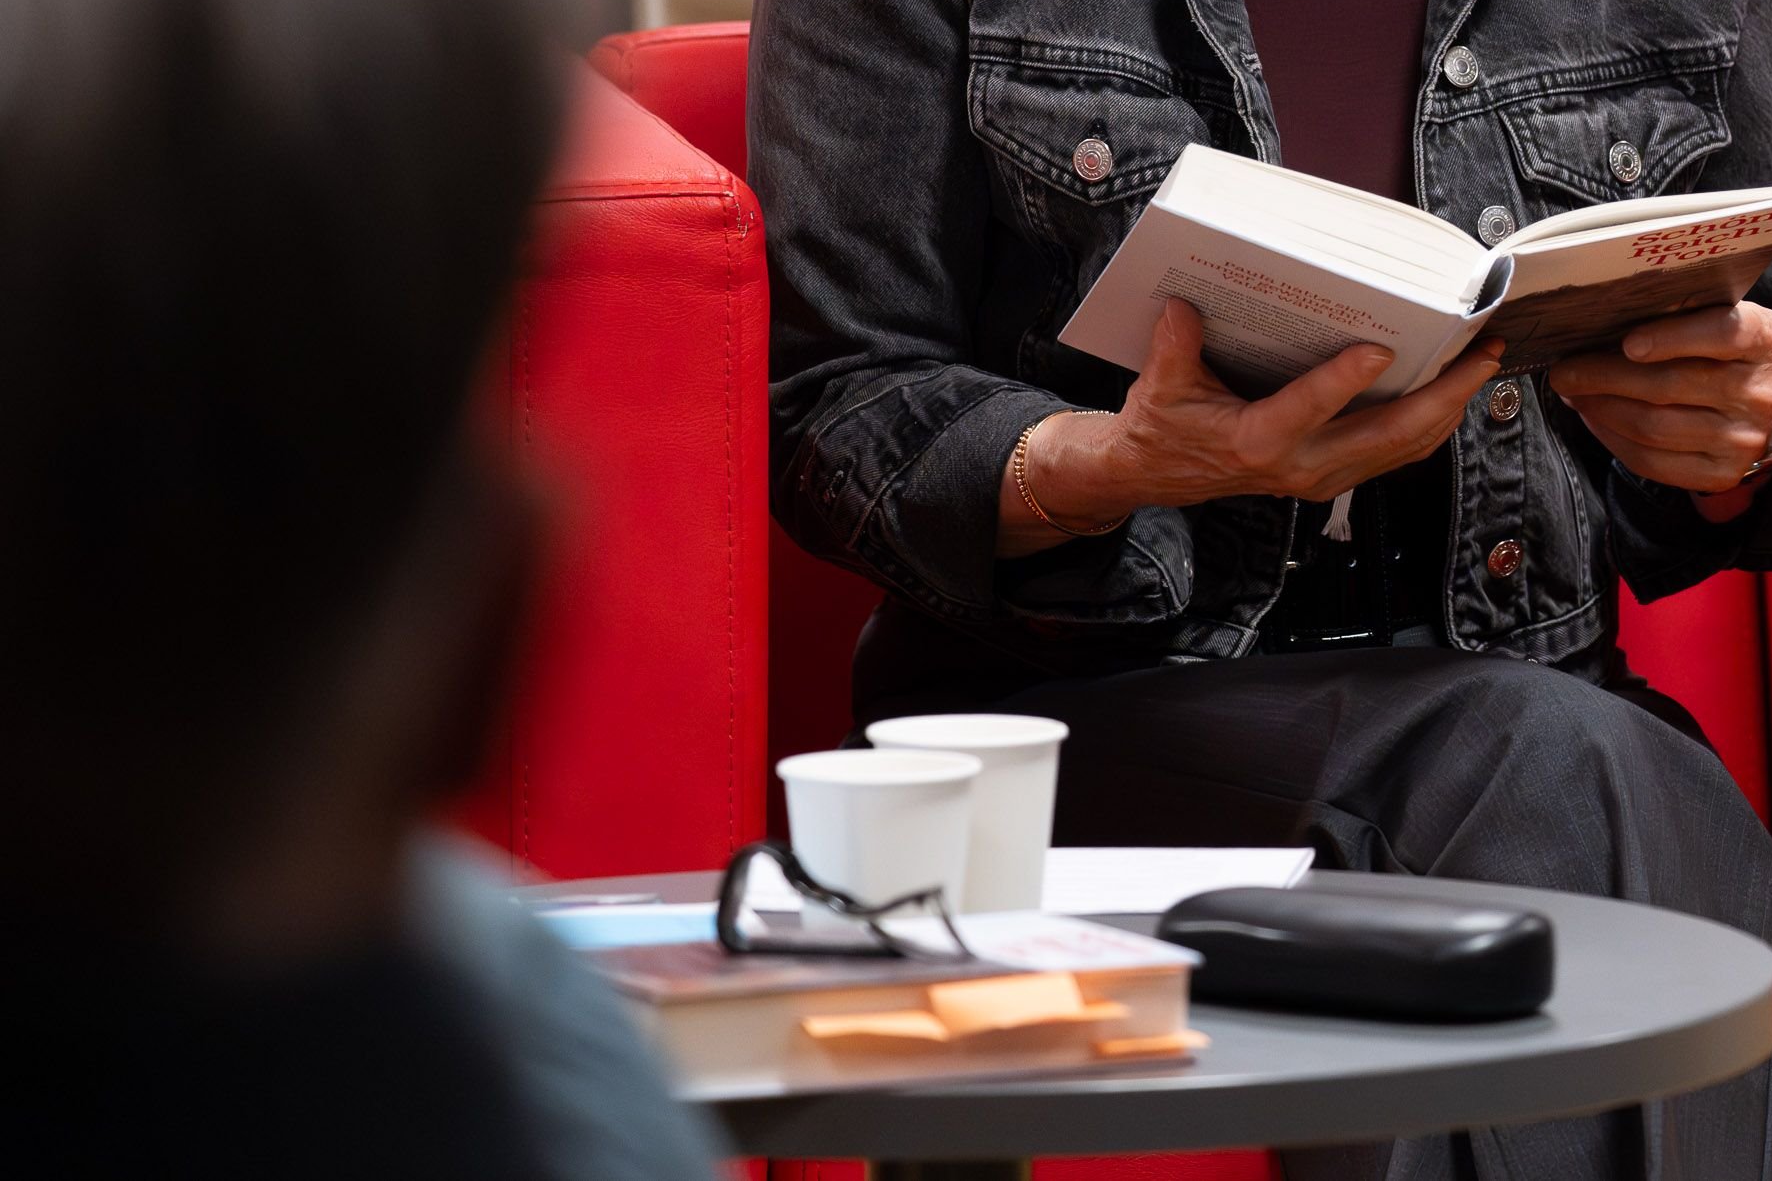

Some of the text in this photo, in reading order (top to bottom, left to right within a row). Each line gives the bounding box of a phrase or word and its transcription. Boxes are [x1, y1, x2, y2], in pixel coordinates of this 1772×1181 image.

[1627, 227, 1772, 260] Reich.
[1646, 243, 1738, 266] Tot.
[1223, 272, 1272, 295] Vater
[1224, 261, 1273, 283] Paula
[1336, 302, 1372, 320] sich
[1372, 322, 1400, 336] ihr
